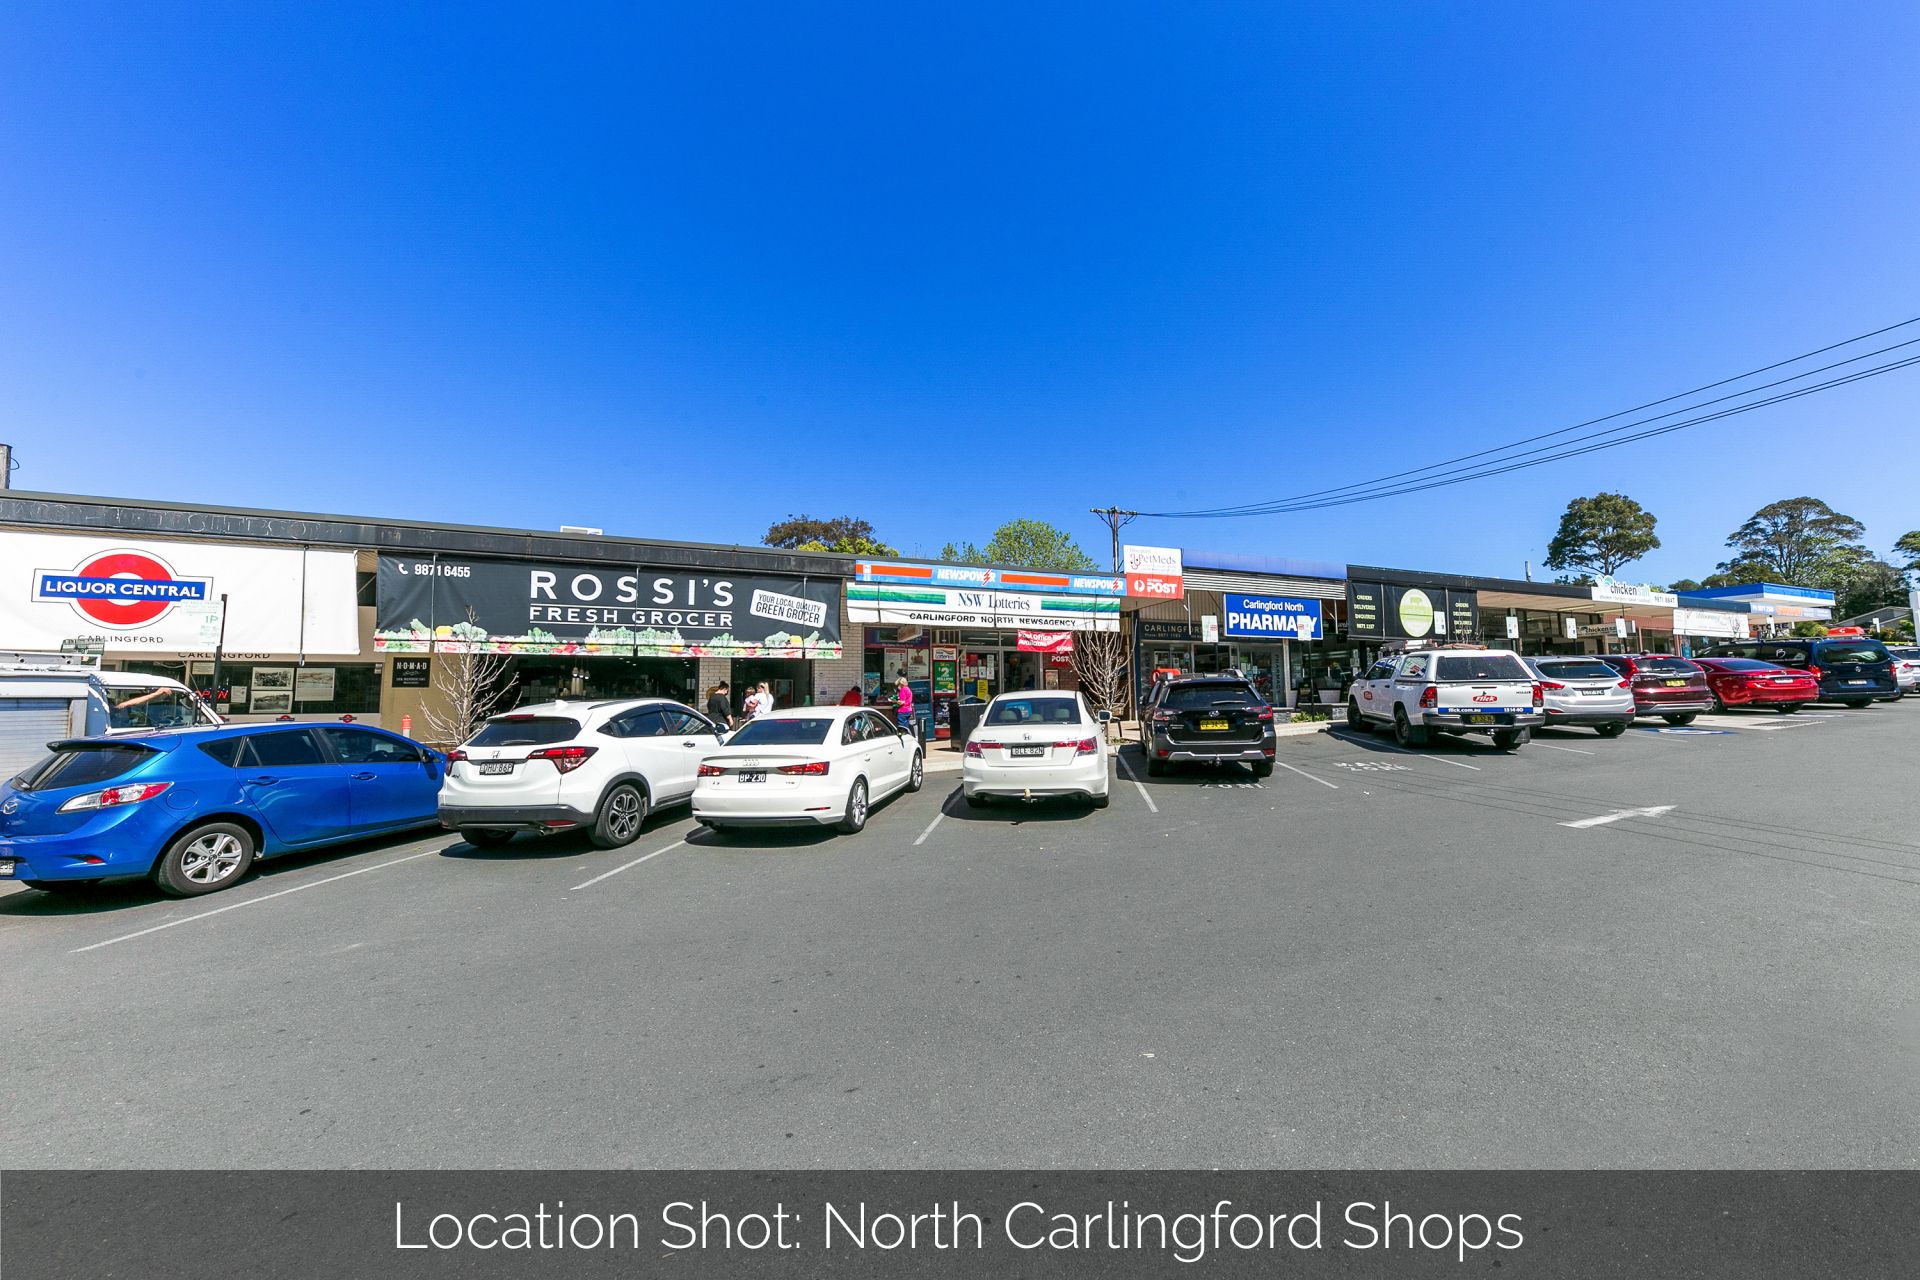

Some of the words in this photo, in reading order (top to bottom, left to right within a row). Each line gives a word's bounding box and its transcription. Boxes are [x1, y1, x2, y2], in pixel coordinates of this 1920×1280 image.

[444, 565, 471, 578] 6455
[45, 581, 117, 594] LIQUOR
[120, 582, 200, 597] CENTRAL
[530, 570, 734, 607] ROSSI'S
[1147, 583, 1177, 594] POST
[758, 593, 775, 604] YOUR
[775, 597, 795, 608] LOCAL
[796, 601, 822, 613] QUALITY
[957, 592, 985, 607] NSW
[988, 595, 1031, 611] Lotteries
[1243, 599, 1284, 612] Carlingford
[1284, 602, 1305, 612] North
[529, 607, 618, 623] FRESH
[631, 611, 733, 627] GROCER
[755, 601, 785, 617] GREEN
[786, 607, 820, 624] GROCER
[909, 612, 976, 623] CARLINGFORD
[981, 616, 1014, 625] NORTH
[1018, 617, 1077, 628] NEWSAGENCY
[1228, 612, 1318, 633] PHARMAY
[1051, 655, 1070, 663] POST
